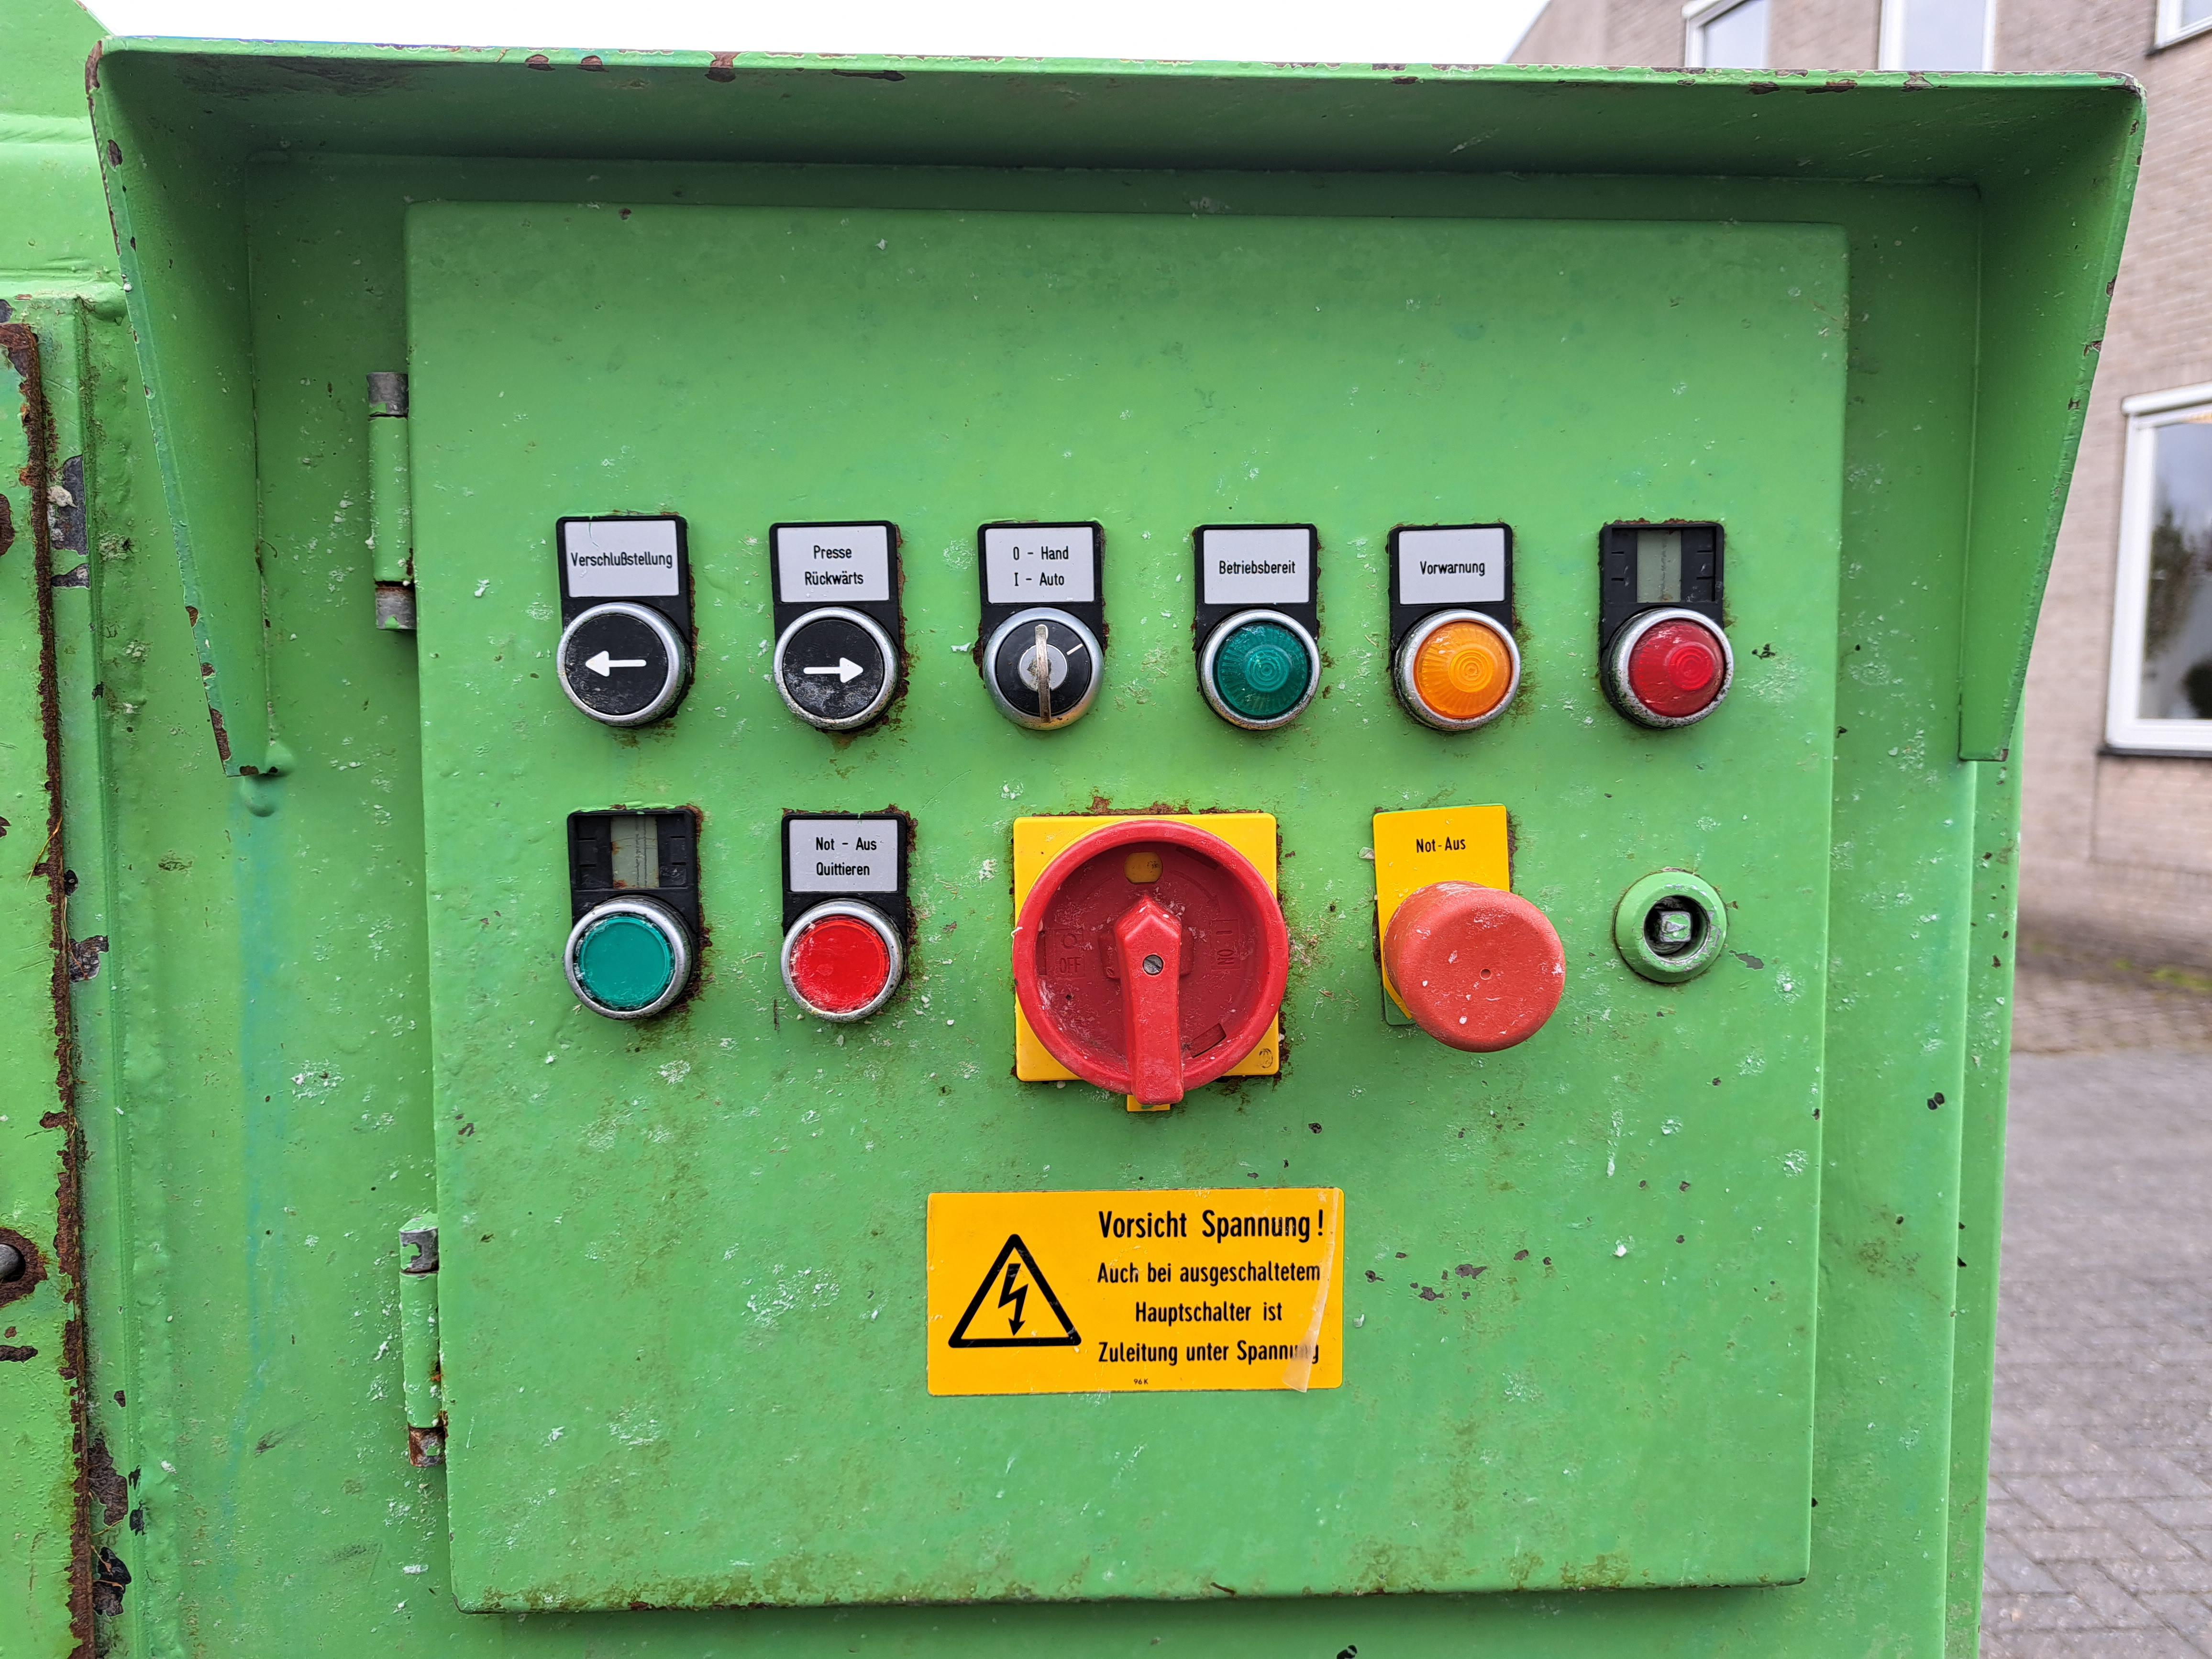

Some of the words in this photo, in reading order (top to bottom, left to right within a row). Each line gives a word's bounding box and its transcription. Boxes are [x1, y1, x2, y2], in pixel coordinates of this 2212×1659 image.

[813, 545, 852, 559] Presse
[1041, 546, 1069, 560] Hand
[570, 552, 673, 569] Verschlußstellung
[1219, 560, 1295, 575] Betriebsbereit
[1420, 561, 1485, 576] Vorwarnung
[805, 571, 863, 586] Rückwärts
[1040, 572, 1064, 586] Auto
[816, 837, 835, 851] Not
[855, 837, 877, 851] Aus
[816, 862, 870, 876] Quittieren
[1059, 957, 1083, 973] OFF
[1099, 1210, 1187, 1238] Vorsicht
[1097, 1262, 1139, 1283] Auch
[1148, 1262, 1171, 1283] bei
[1180, 1261, 1320, 1287] ausgeschaltetem
[1136, 1301, 1251, 1327] Hauptschalter
[1263, 1302, 1283, 1321] ist
[1098, 1342, 1177, 1366] Zuleitung
[1186, 1343, 1229, 1361] unter
